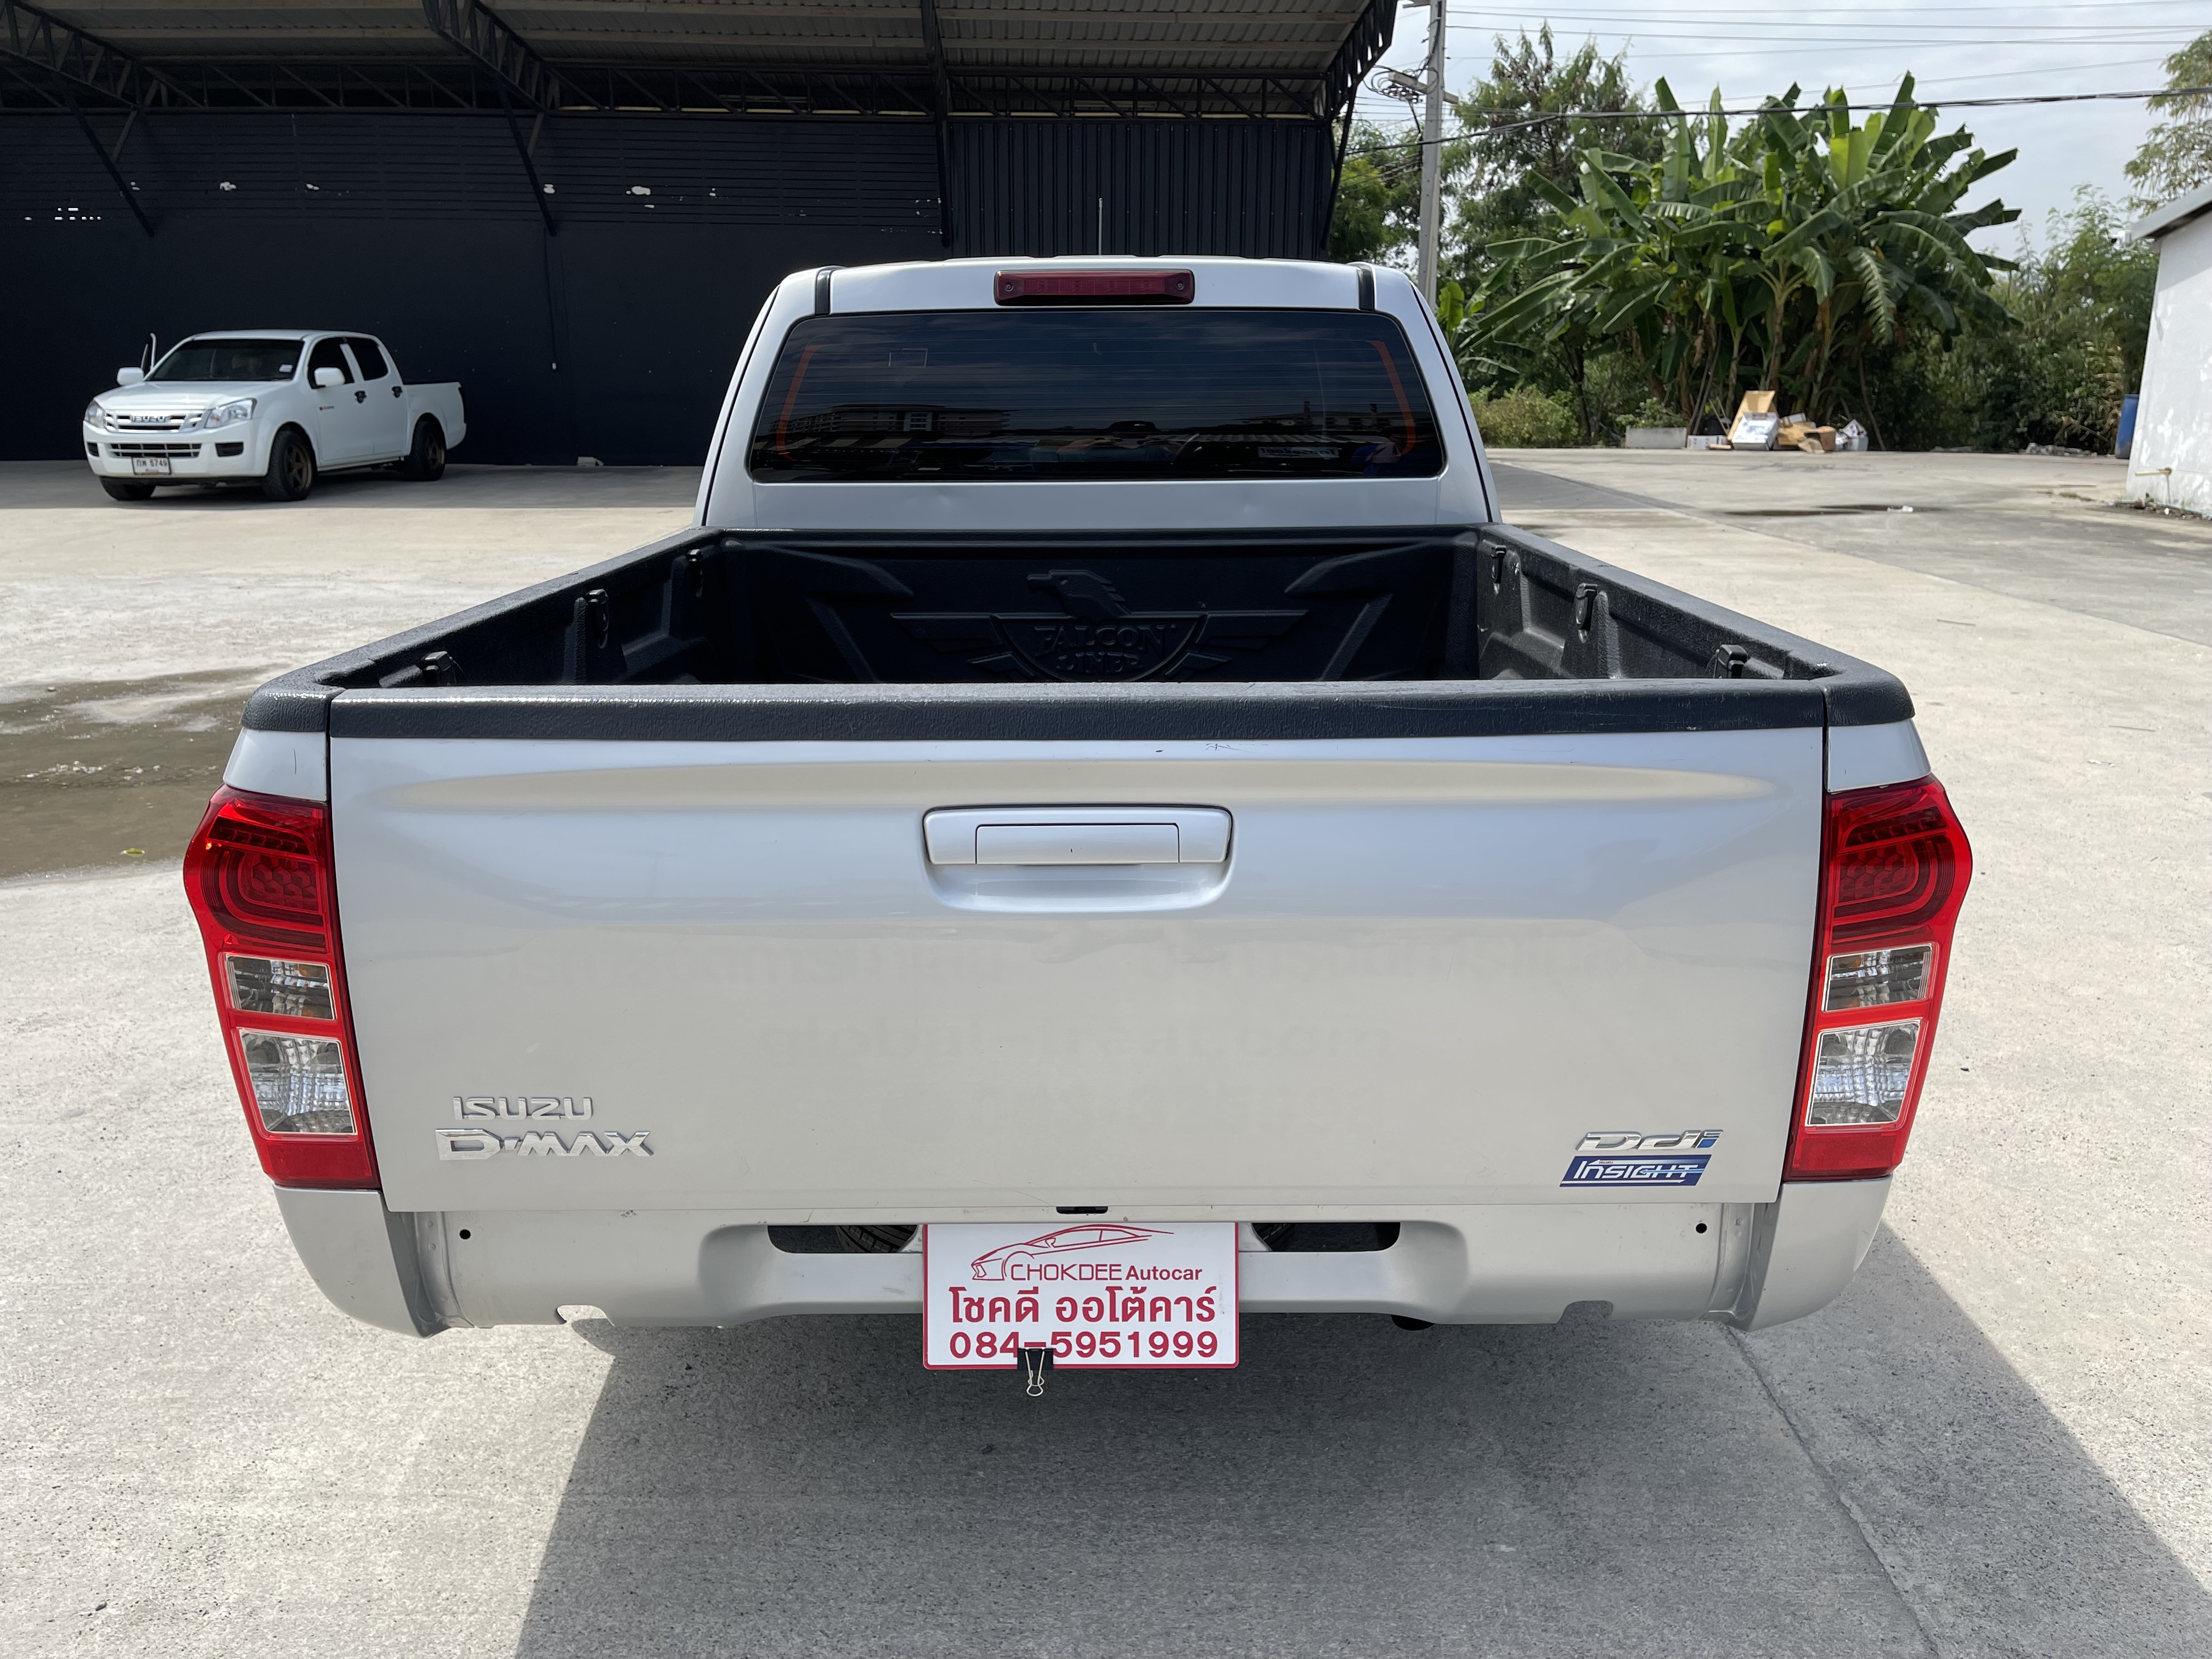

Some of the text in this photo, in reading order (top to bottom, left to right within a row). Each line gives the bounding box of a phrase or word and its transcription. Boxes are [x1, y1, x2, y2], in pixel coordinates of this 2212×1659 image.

[1034, 625, 1165, 658] FALCON
[453, 1096, 593, 1120] ISUZU
[435, 1128, 653, 1160] D-MAX
[1010, 1263, 1203, 1281] CHOKDEE Autocar
[948, 1285, 1217, 1323] โชคดี ออโต้คาร์
[949, 1331, 1218, 1359] 084-5951999
